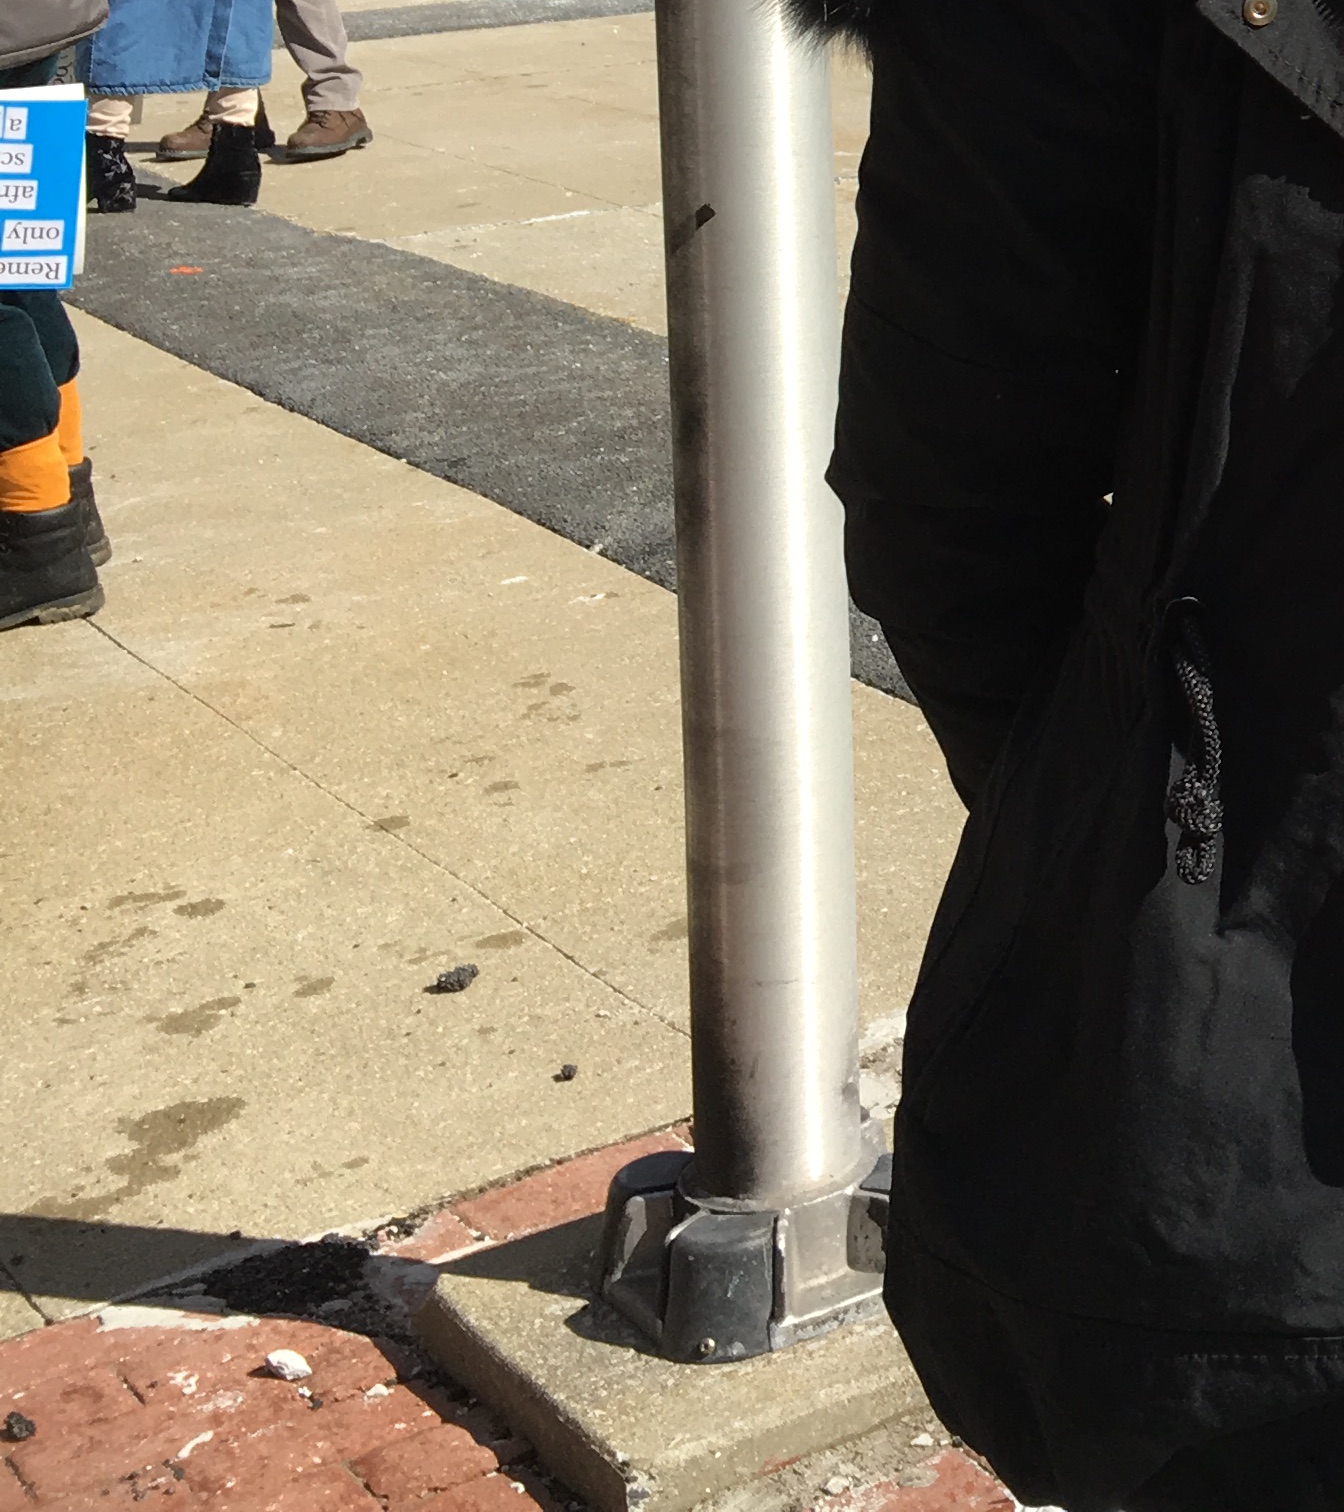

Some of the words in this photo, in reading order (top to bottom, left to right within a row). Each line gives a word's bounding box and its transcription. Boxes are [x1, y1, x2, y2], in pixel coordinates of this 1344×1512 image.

[9, 117, 23, 133] a
[0, 151, 25, 166] sc
[6, 221, 61, 242] only
